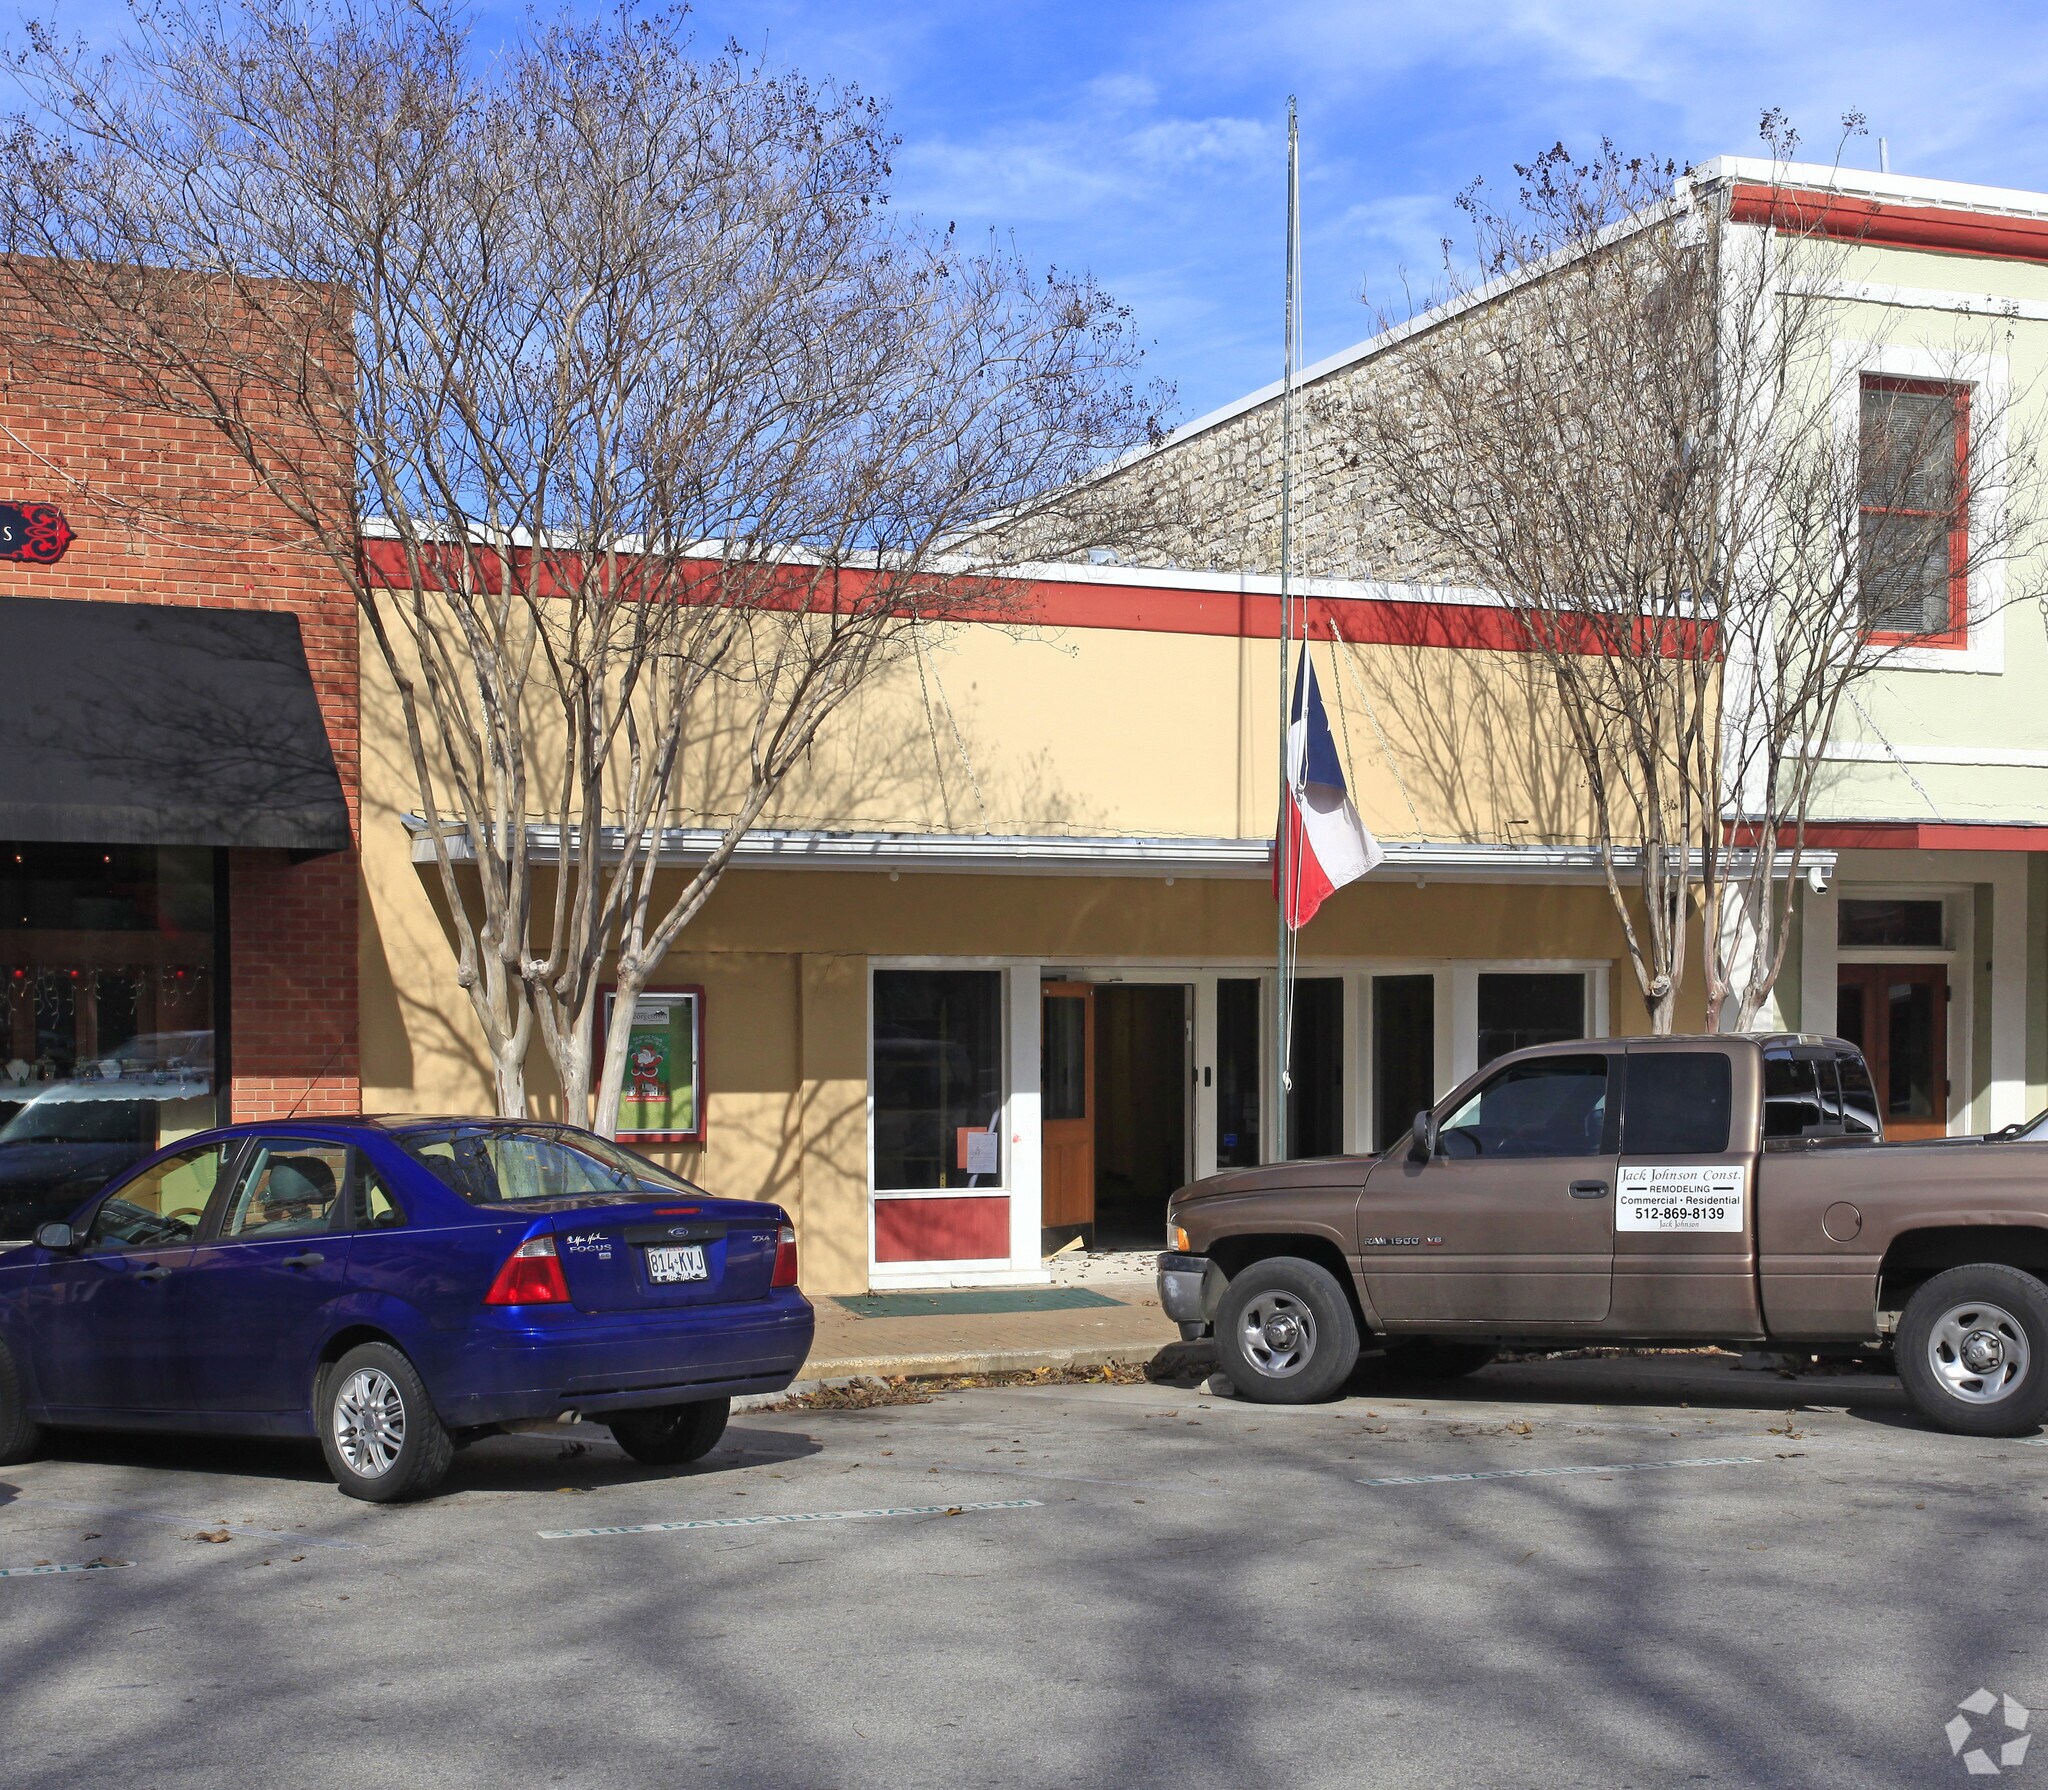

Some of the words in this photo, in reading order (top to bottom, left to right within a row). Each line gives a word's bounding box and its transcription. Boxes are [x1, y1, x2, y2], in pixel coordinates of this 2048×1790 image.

[1621, 1169, 1646, 1183] Jack
[1650, 1168, 1698, 1182] Johnson
[1703, 1170, 1741, 1181] Const.
[1649, 1185, 1710, 1193] REMODELING
[1621, 1196, 1677, 1204] Commercial
[1686, 1195, 1740, 1204] Residential
[1635, 1207, 1725, 1219] 512-869-8139
[1659, 1220, 1673, 1229] Jack
[1674, 1220, 1700, 1228] Johnson
[1364, 1237, 1387, 1245] RAM
[1390, 1237, 1420, 1245] 1500
[569, 1244, 612, 1253] FOCUS
[661, 1514, 843, 1529] PARKING
